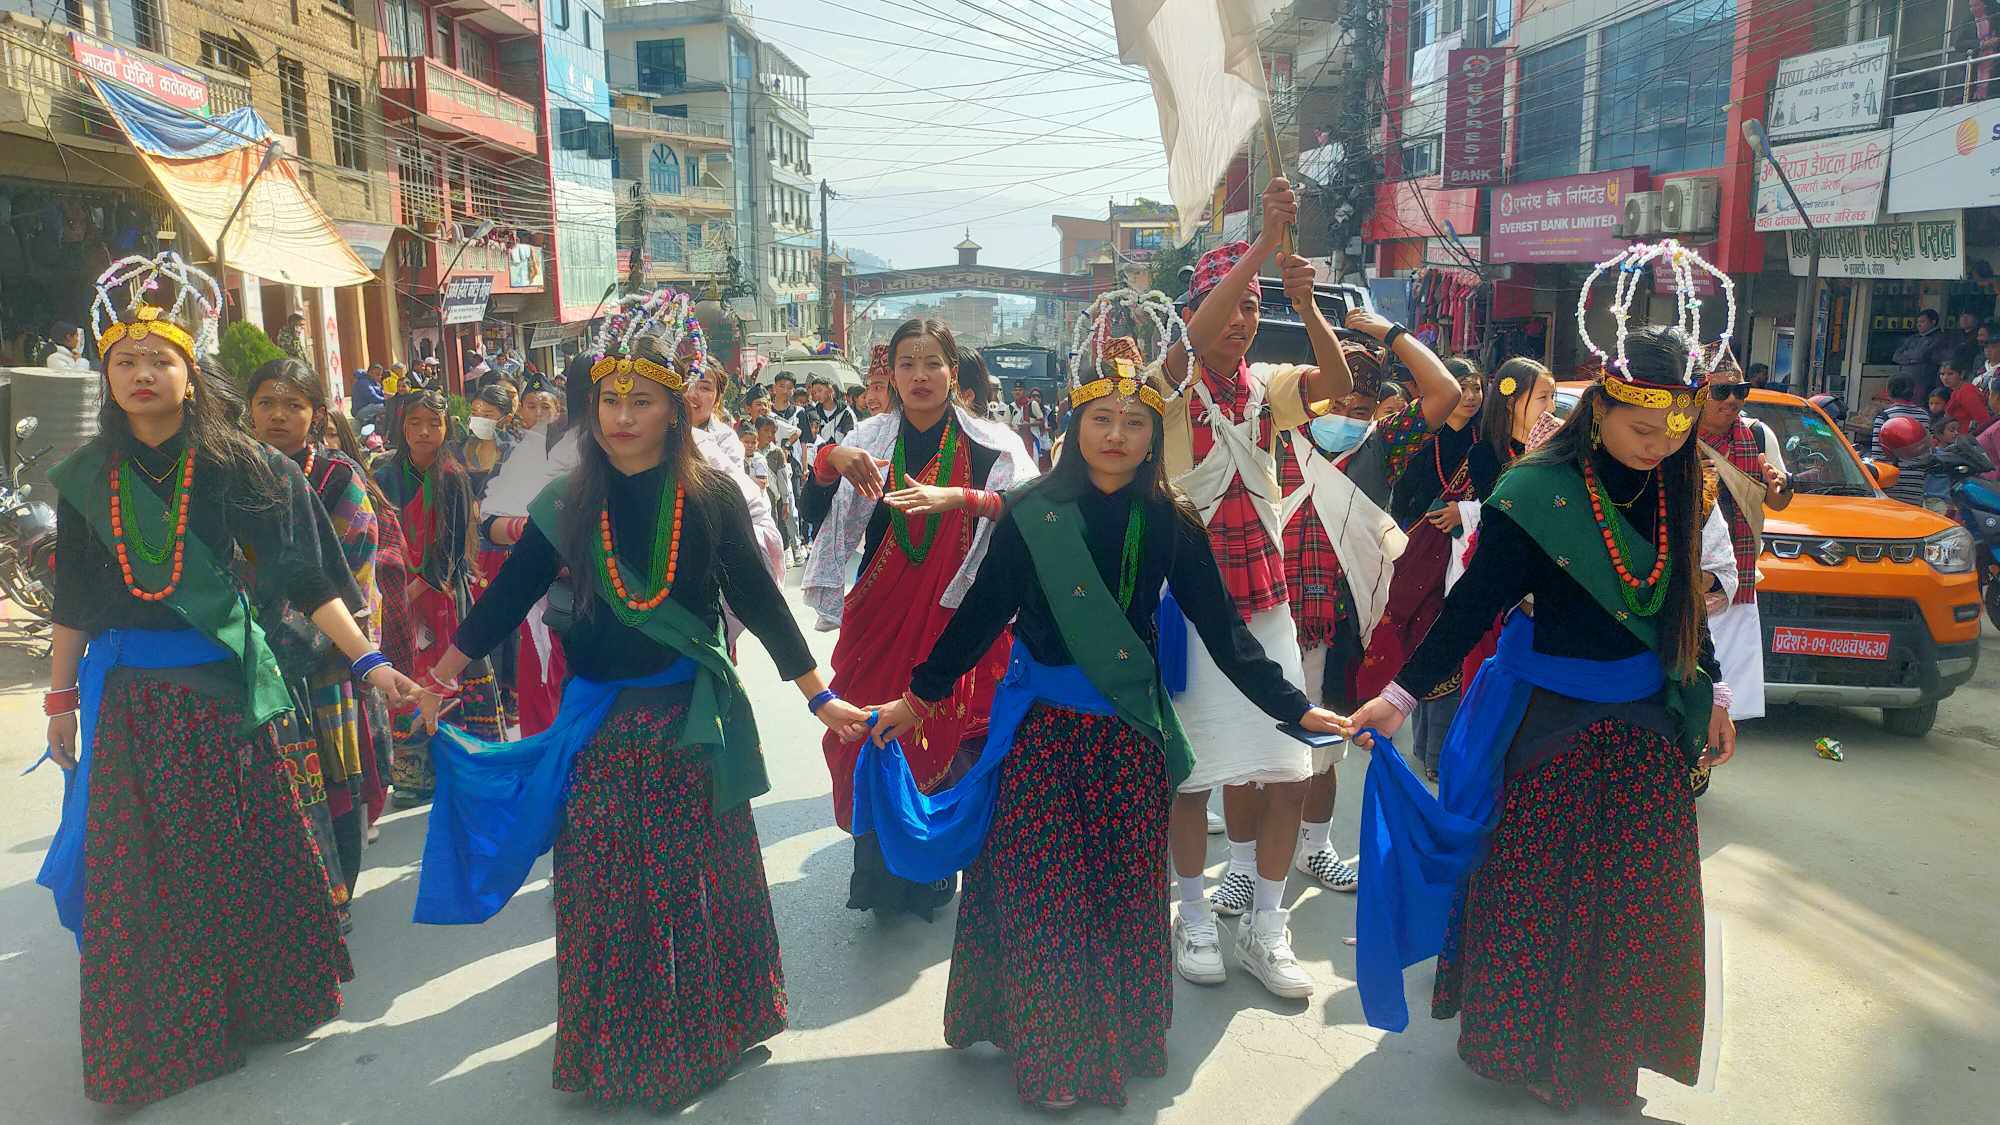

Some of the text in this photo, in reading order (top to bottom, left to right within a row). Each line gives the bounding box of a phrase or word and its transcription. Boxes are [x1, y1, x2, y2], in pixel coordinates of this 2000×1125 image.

[1463, 83, 1484, 164] EVEREST
[1451, 169, 1491, 181] BANK
[1566, 184, 1606, 205] लिमिटेड
[1500, 214, 1617, 234] EVEREST BANK LIMITED
